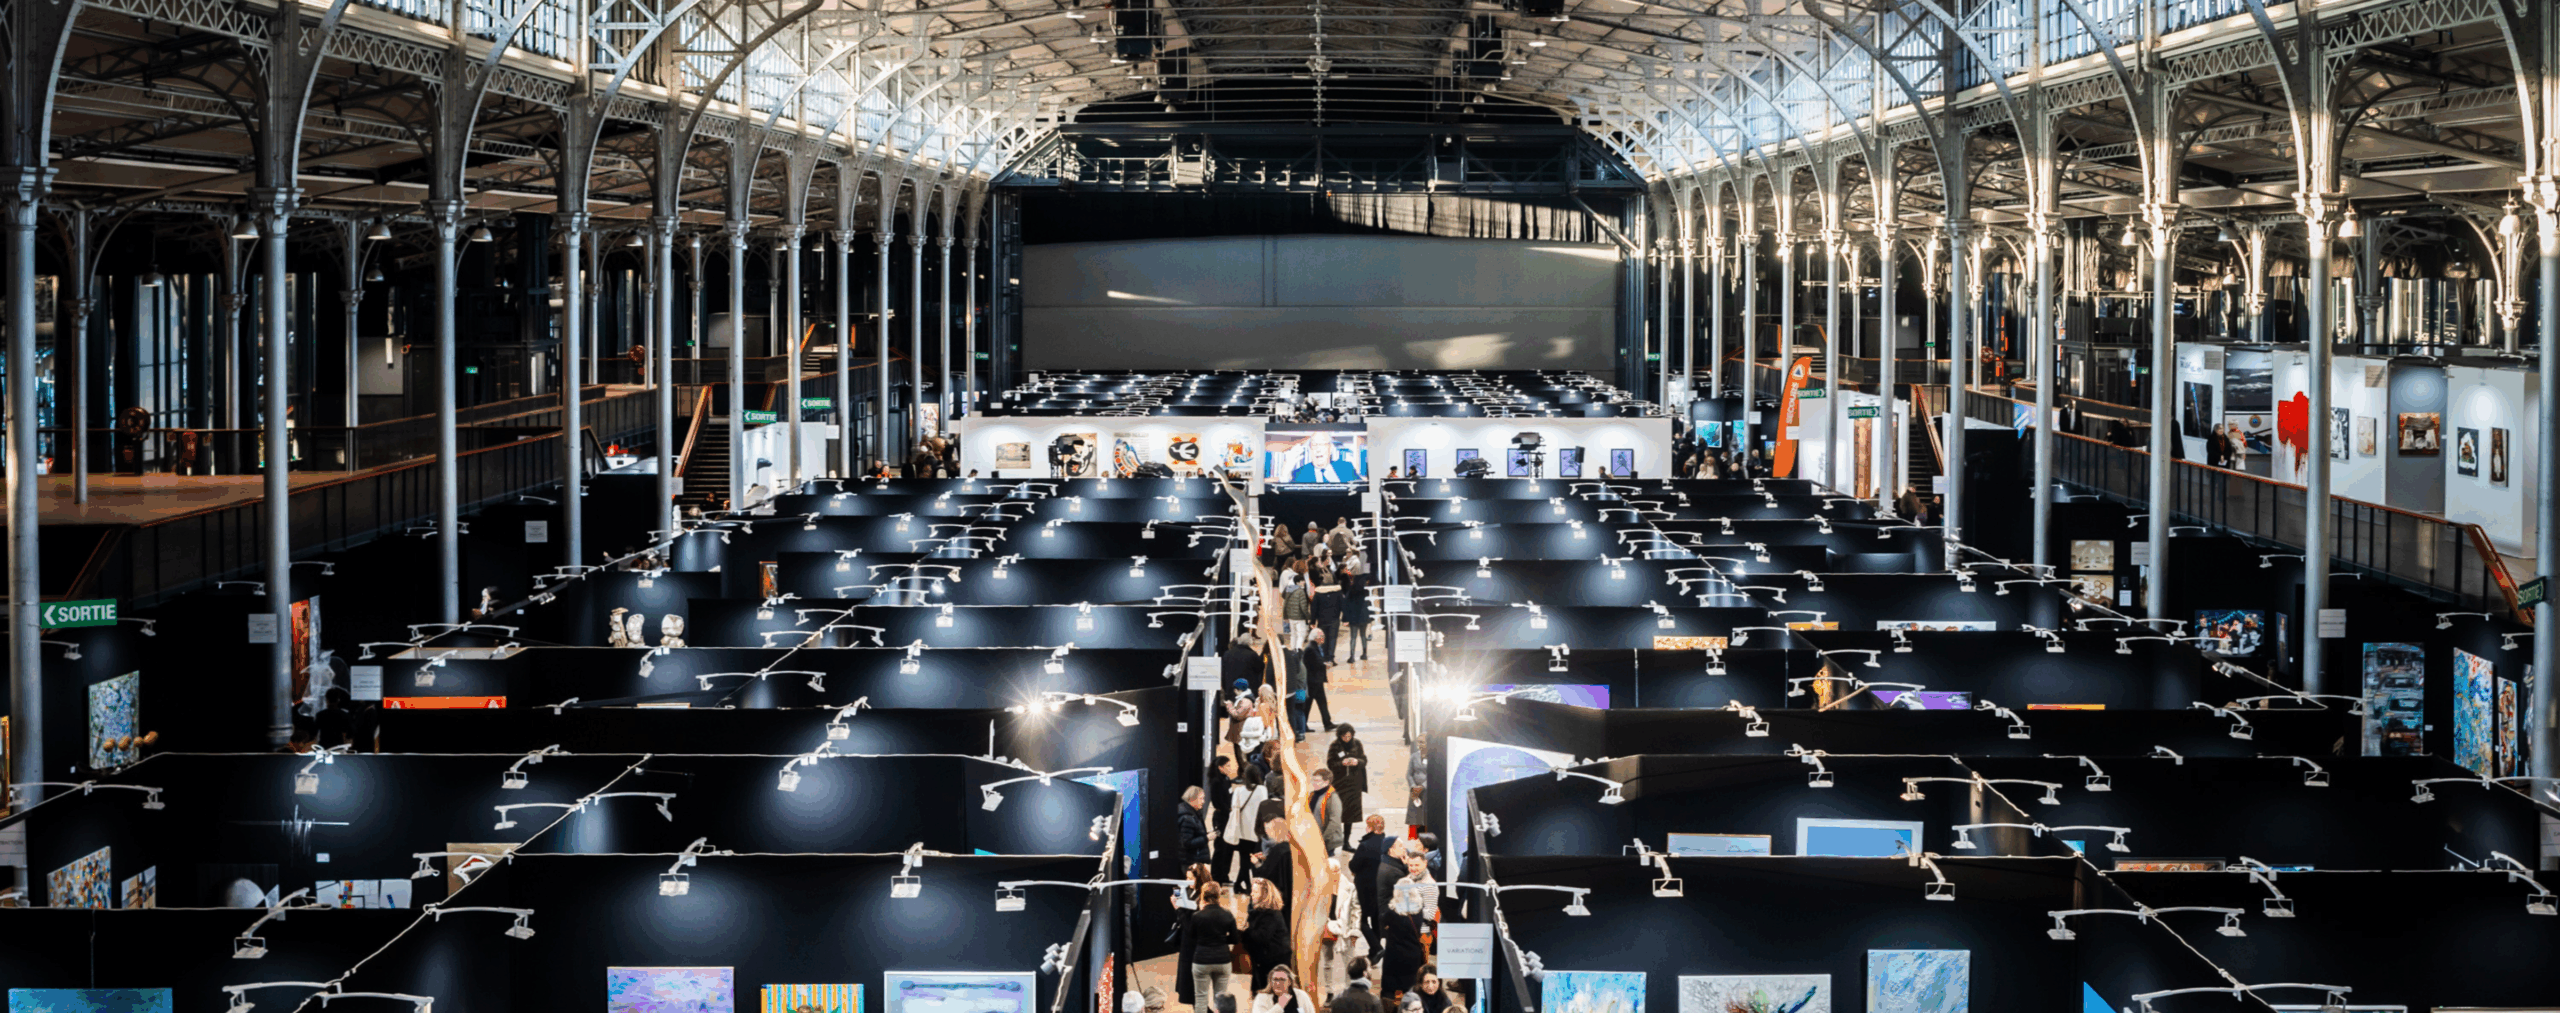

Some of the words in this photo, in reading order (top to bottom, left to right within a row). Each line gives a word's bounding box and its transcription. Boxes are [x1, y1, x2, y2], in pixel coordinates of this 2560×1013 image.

[1785, 382, 1799, 424] SECOURS
[750, 412, 777, 421] SORTIE
[1847, 408, 1874, 416] SORTIE
[58, 603, 116, 623] SORTIE
